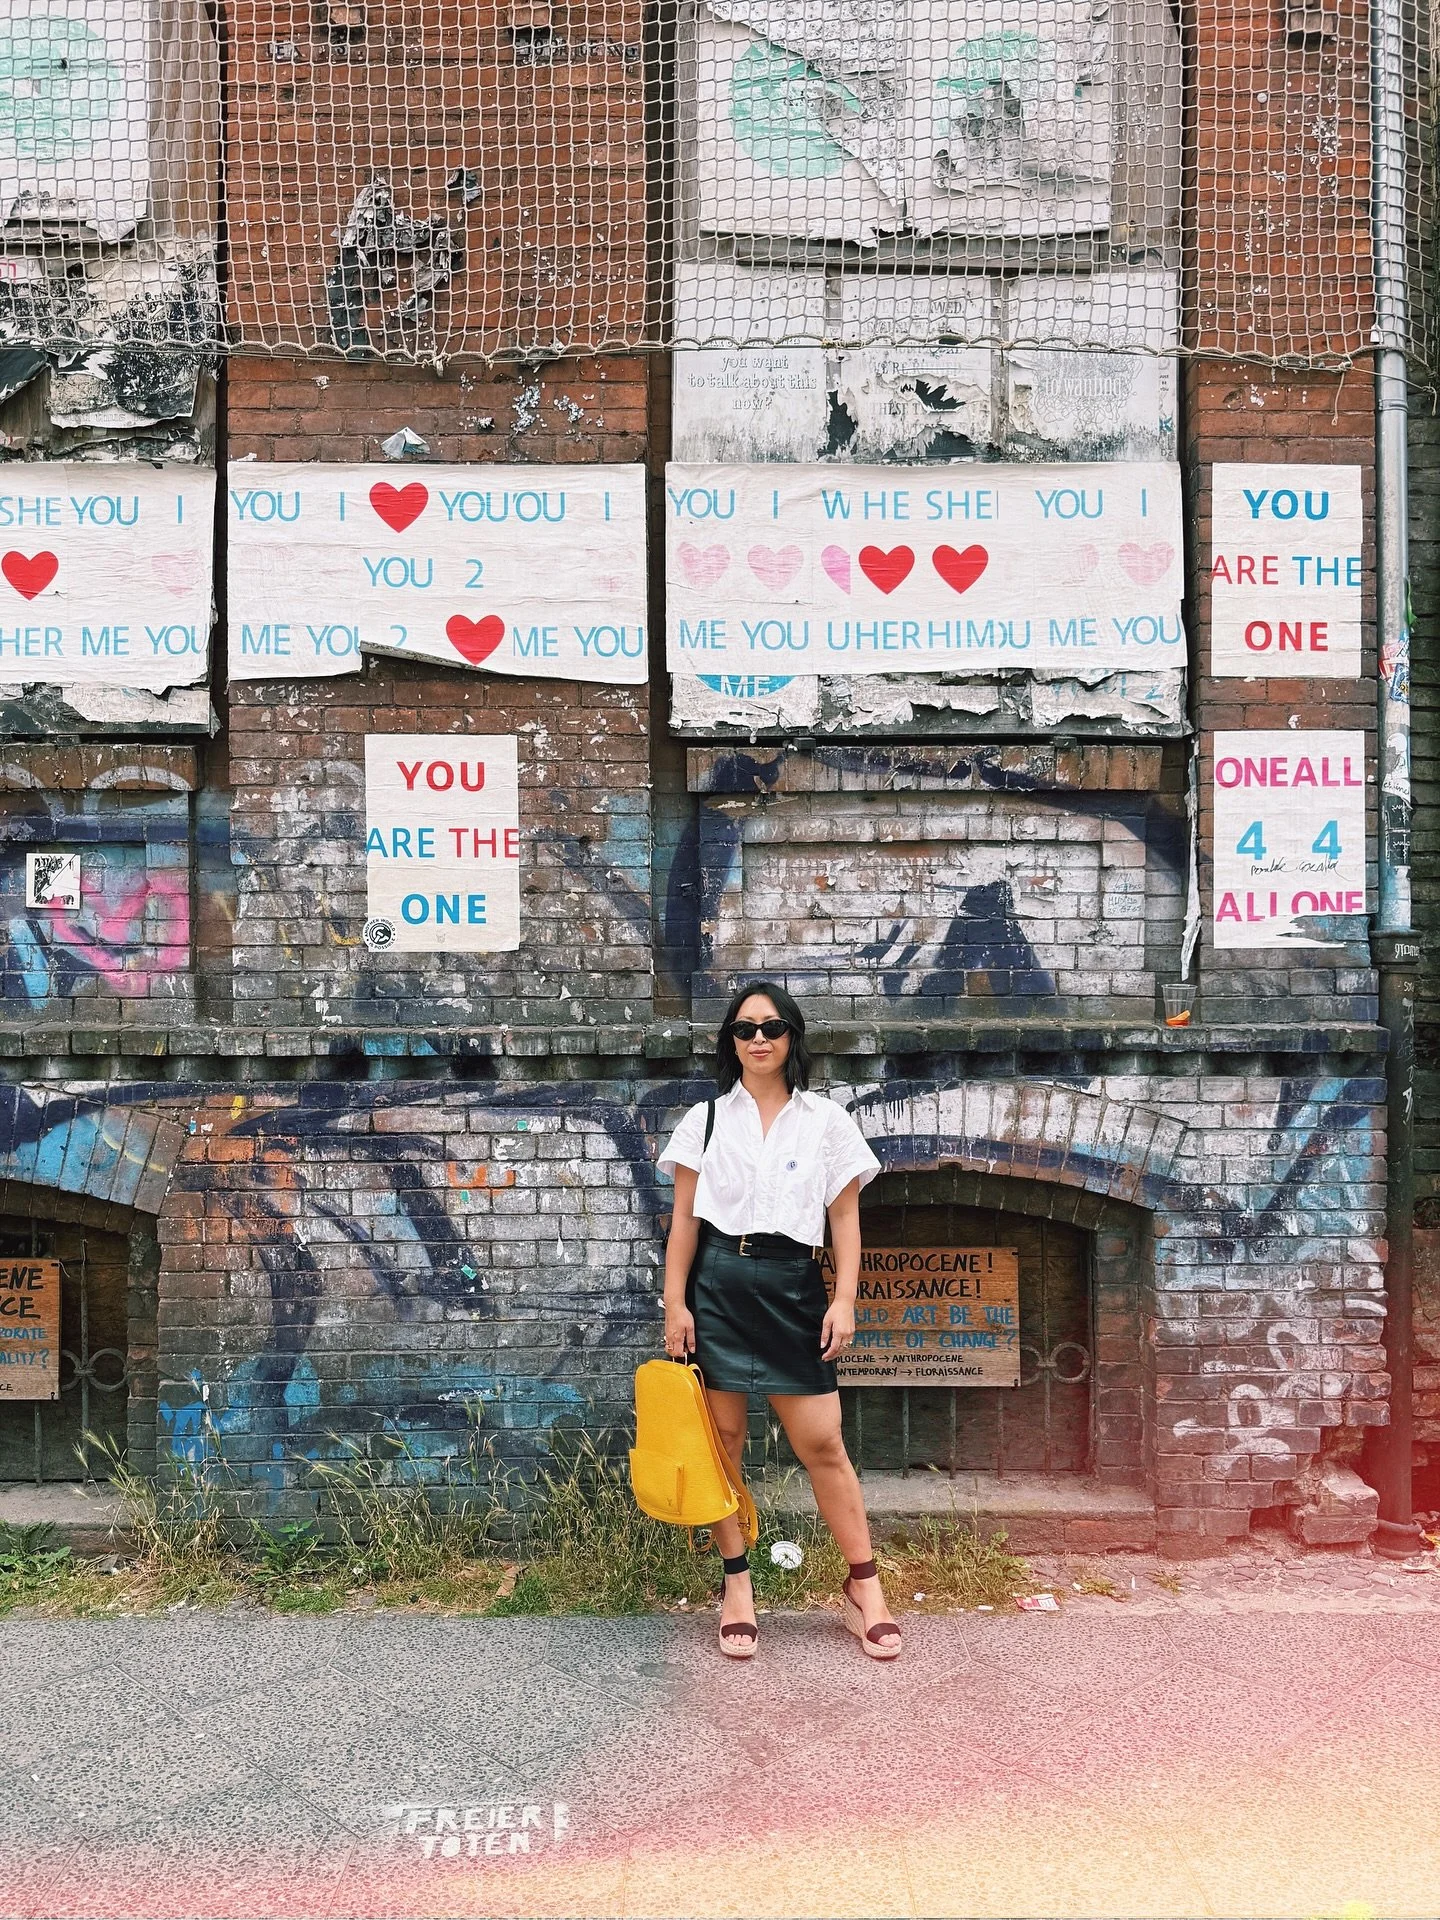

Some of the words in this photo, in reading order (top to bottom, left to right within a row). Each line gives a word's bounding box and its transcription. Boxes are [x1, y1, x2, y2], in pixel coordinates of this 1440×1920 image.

[721, 355, 747, 373] you
[752, 355, 789, 369] want
[688, 374, 705, 388] to
[707, 373, 740, 389] talk
[742, 373, 786, 389] about
[788, 374, 817, 389] this
[732, 398, 773, 411] now?
[70, 495, 139, 526] YOU
[177, 494, 183, 524] I
[230, 490, 301, 522] YOU
[339, 491, 345, 522] I
[512, 490, 566, 522] OU
[604, 491, 610, 522] I
[667, 488, 736, 519] YOU
[772, 490, 779, 520] I
[864, 490, 910, 521] HE
[926, 490, 992, 521] SHE
[1035, 488, 1103, 520] YOU
[1141, 488, 1147, 517] I
[1242, 489, 1330, 521] YOU
[362, 556, 434, 588] YOU
[464, 558, 484, 589] 2
[1211, 554, 1279, 585] ARE
[1292, 556, 1361, 587] THE
[0, 626, 64, 657] HER
[82, 626, 130, 657] ME
[144, 624, 208, 656] YOU
[241, 624, 291, 656] ME
[512, 626, 560, 657] ME
[573, 625, 644, 658] YOU
[679, 619, 727, 650] ME
[741, 620, 809, 651] YOU
[1049, 618, 1097, 647] ME
[1112, 616, 1182, 646] YOU
[1244, 620, 1329, 652] ONE
[396, 760, 486, 792] YOU
[365, 827, 435, 858] ARE
[448, 828, 519, 858] THE
[1236, 820, 1267, 861] 4
[1312, 819, 1342, 860] 4
[401, 893, 487, 925] ONE
[902, 1305, 939, 1325] ART
[949, 1304, 974, 1326] BE
[982, 1306, 1016, 1326] THE
[906, 1332, 929, 1349] OF
[892, 1354, 964, 1363] ANTHROPOCENE
[418, 1831, 530, 1860] TOTEN
